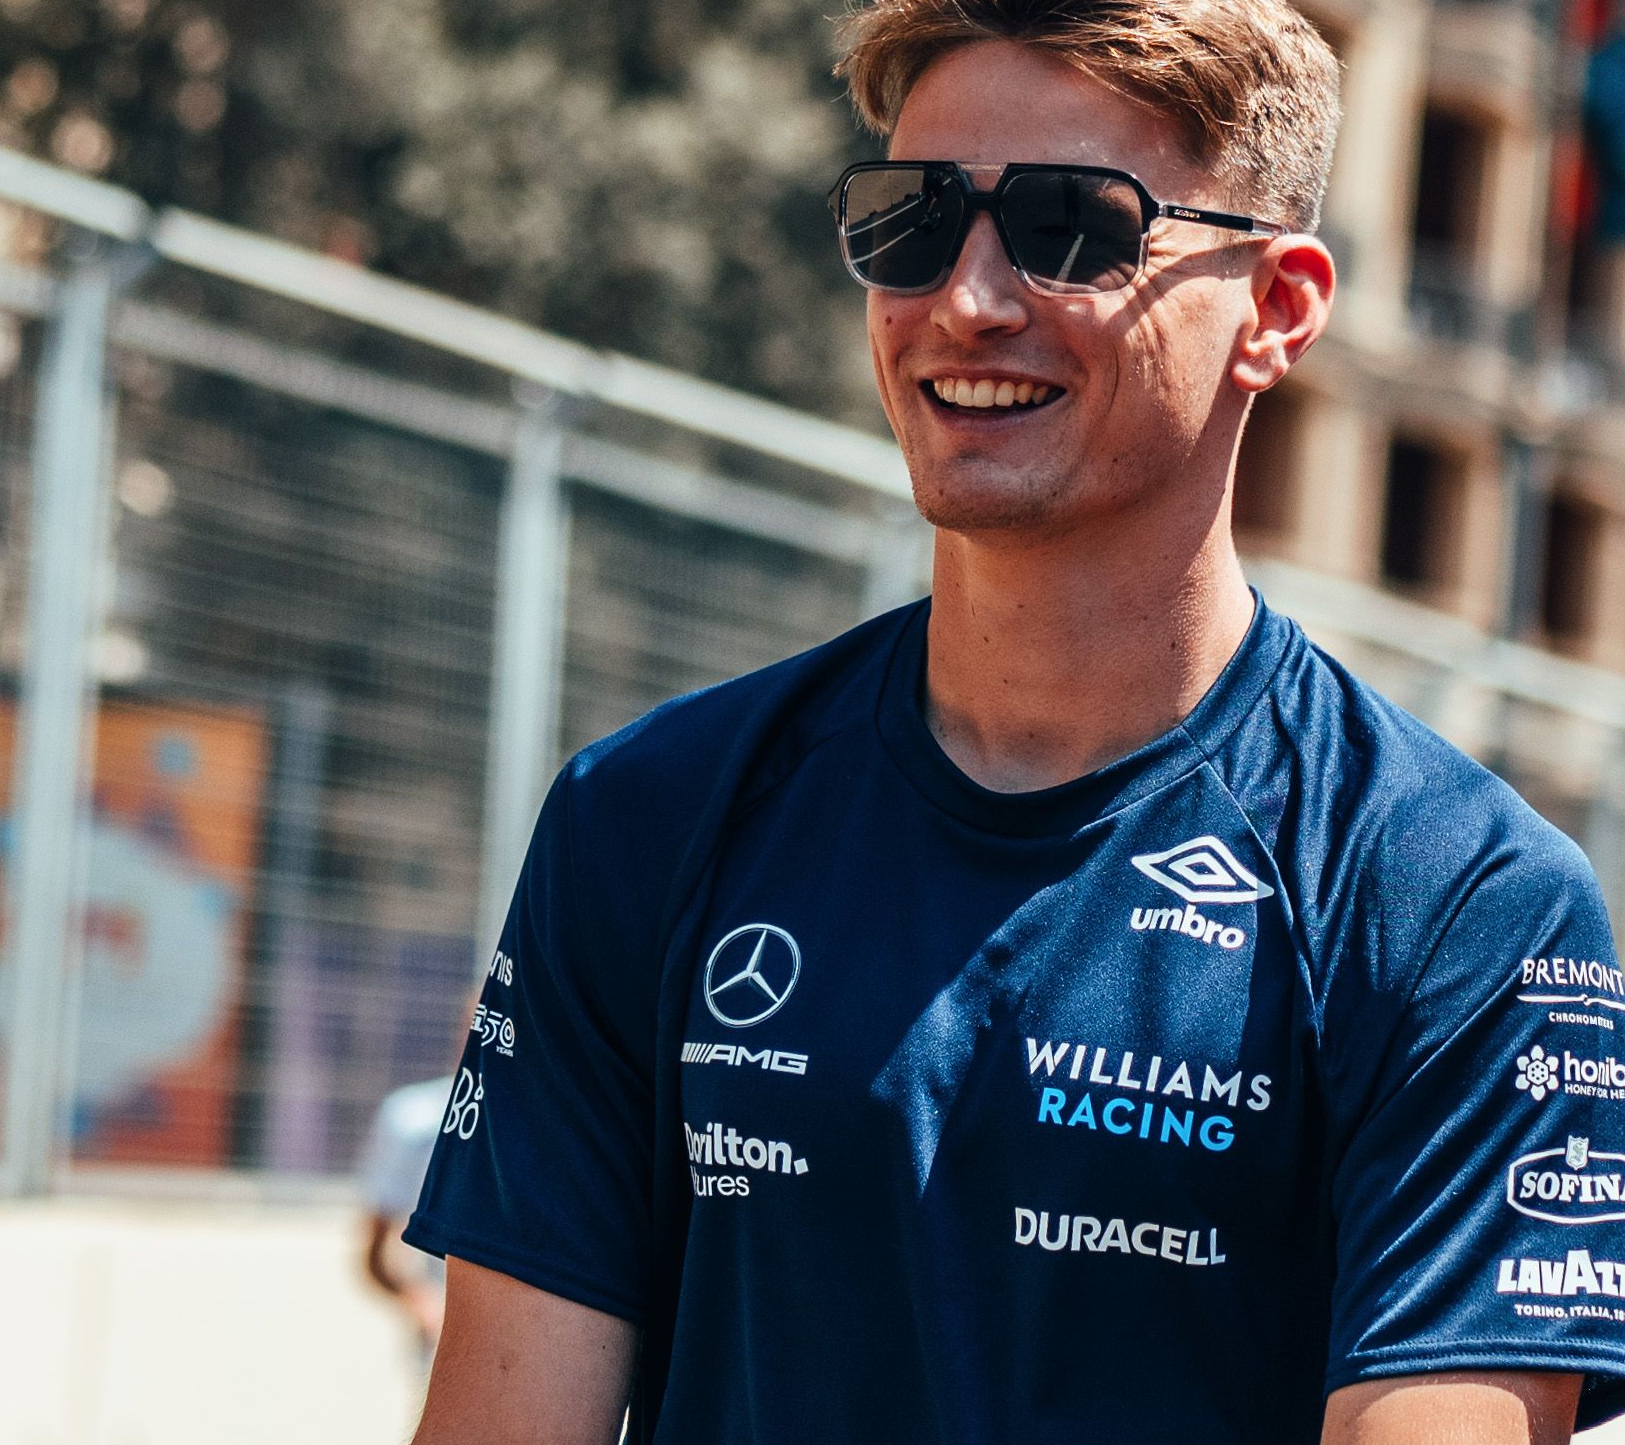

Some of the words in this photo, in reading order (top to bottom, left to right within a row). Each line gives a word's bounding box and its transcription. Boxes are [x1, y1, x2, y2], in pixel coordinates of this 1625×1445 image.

[1130, 906, 1244, 949] umbro
[1522, 957, 1625, 996] BREMONT
[1026, 1038, 1272, 1111] WILLIAMS
[1037, 1087, 1235, 1152] RACING
[1015, 1207, 1226, 1266] DURACELL
